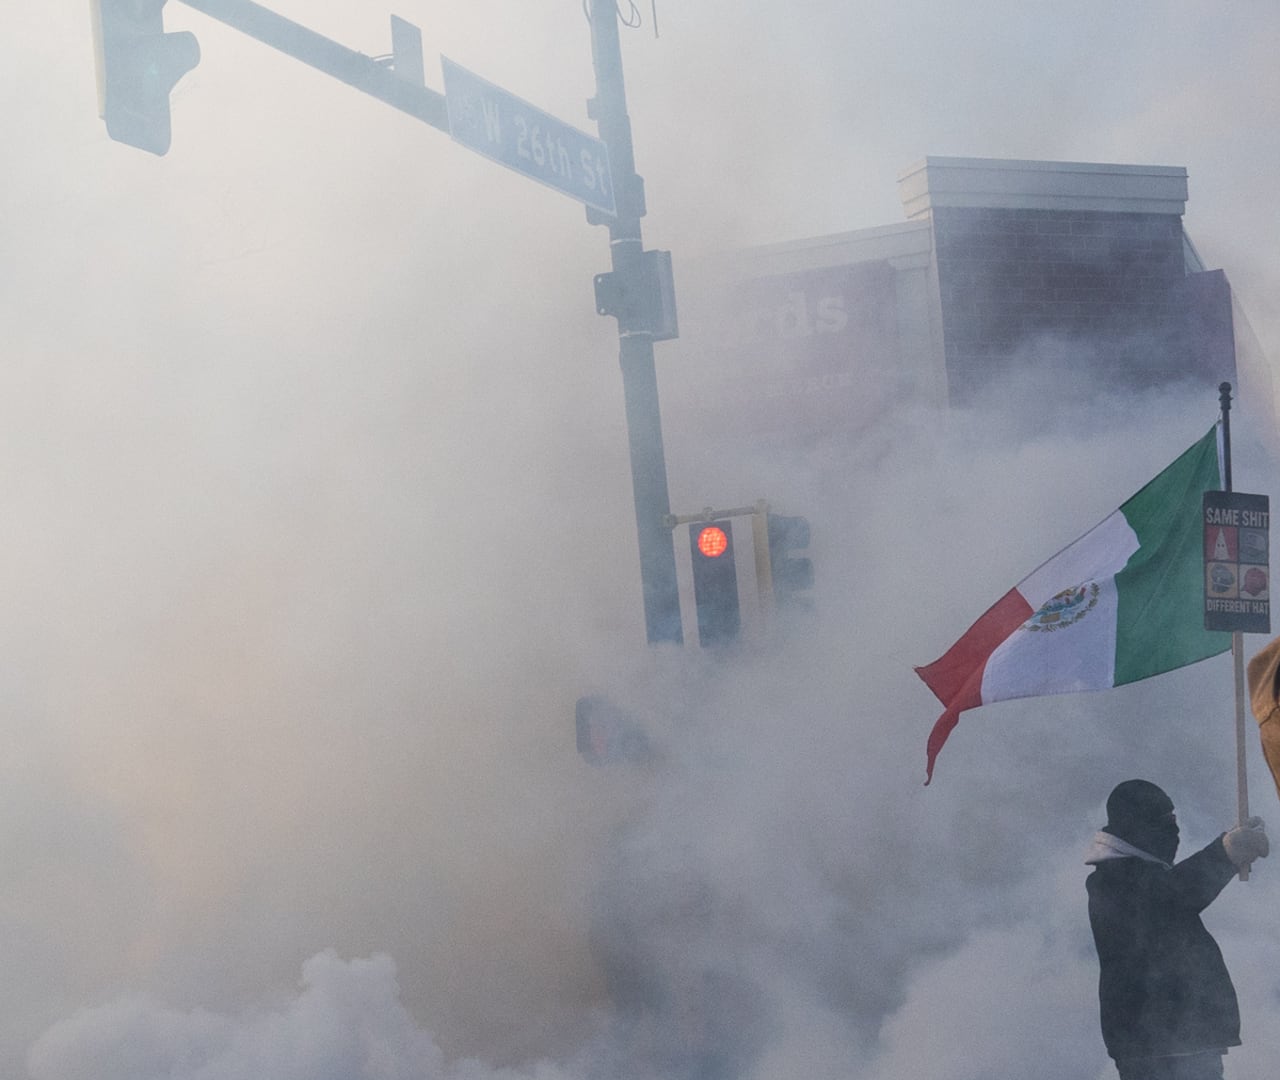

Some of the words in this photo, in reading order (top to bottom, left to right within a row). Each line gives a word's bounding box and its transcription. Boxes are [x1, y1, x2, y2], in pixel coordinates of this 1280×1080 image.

[480, 96, 501, 144] W
[513, 114, 572, 179] 26th
[580, 148, 607, 196] St
[1206, 507, 1239, 525] SAME
[1242, 510, 1269, 528] SHIT
[1207, 600, 1250, 613] DIFFERENT
[1252, 602, 1269, 614] HAT
